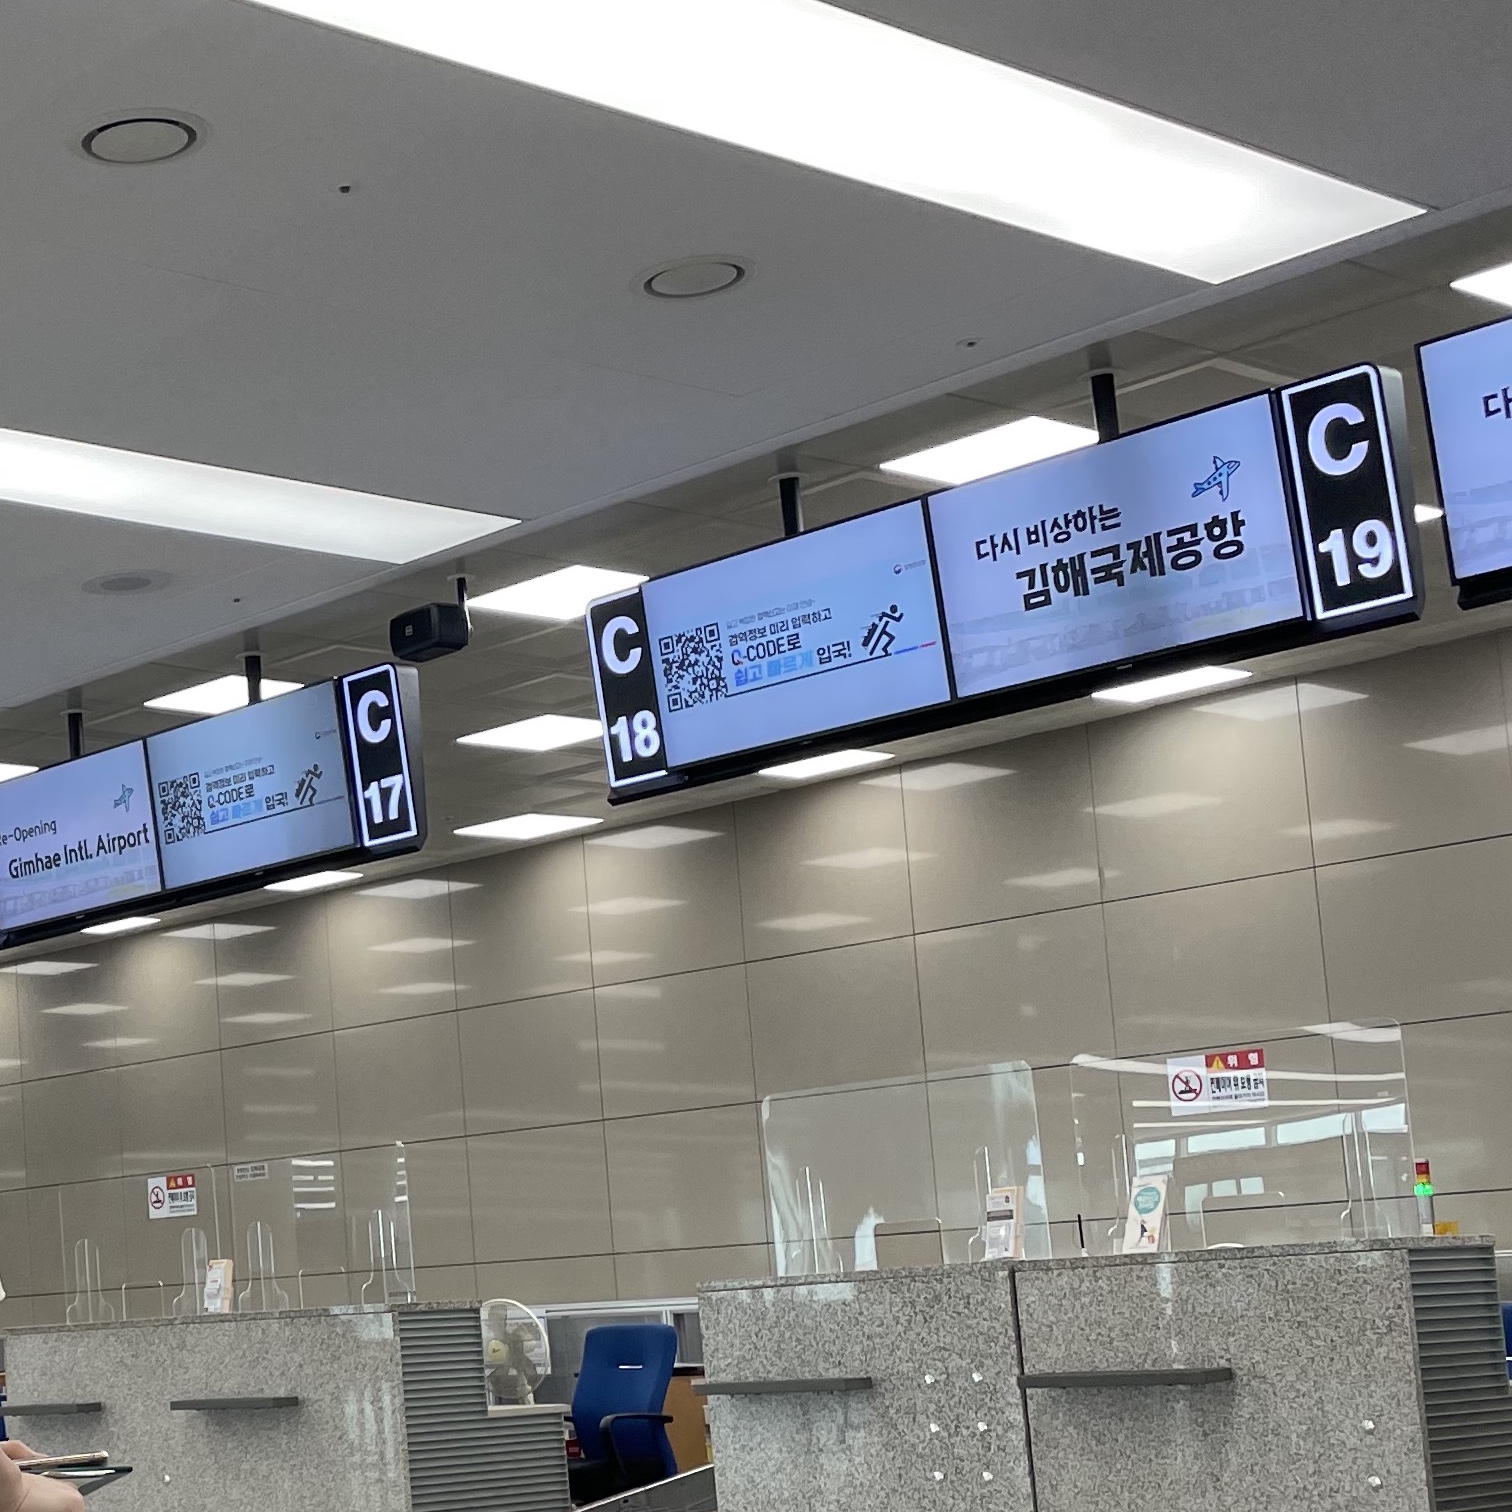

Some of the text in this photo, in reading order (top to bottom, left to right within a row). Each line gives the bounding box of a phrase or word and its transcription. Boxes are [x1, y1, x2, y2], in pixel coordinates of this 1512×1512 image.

[1307, 402, 1369, 476] C
[975, 503, 1122, 562] 다시 비상하는
[1318, 518, 1394, 587] 19
[1015, 510, 1246, 612] 김해국제공항
[601, 615, 642, 675] C
[769, 619, 789, 635] 미리
[816, 640, 852, 665] 입국!
[356, 689, 392, 744] C
[610, 709, 660, 763] 18
[363, 773, 404, 824] 17
[9, 851, 61, 879] Gimhae
[96, 823, 150, 857] Airport
